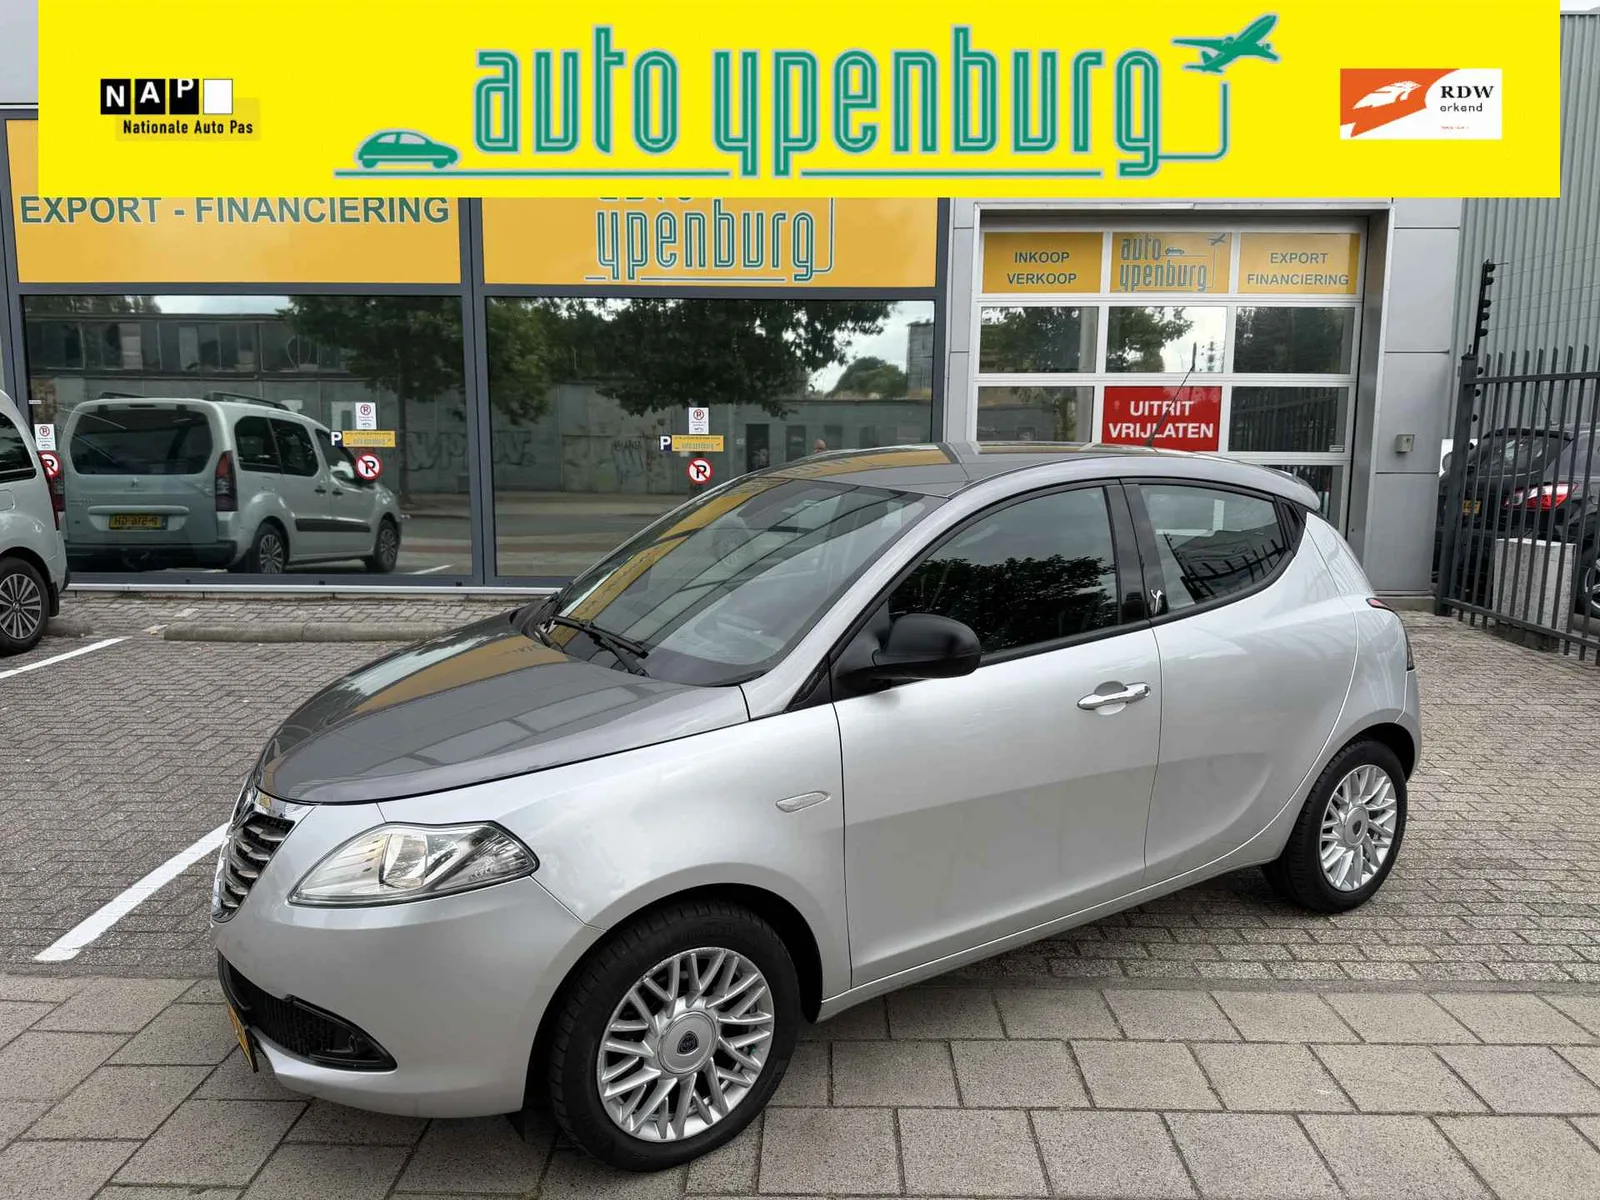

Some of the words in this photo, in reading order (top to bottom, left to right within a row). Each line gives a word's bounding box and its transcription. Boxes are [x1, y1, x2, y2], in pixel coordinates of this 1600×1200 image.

[20, 196, 162, 223] EXPORT
[196, 197, 450, 223] FINANCIERING
[596, 199, 814, 282] ypenburg
[1120, 234, 1162, 261] auto
[1014, 251, 1070, 264] INKOOP
[1269, 252, 1329, 264] EXPORT
[1006, 272, 1078, 285] VERKOOP
[1119, 259, 1207, 292] ypenburg
[1247, 273, 1350, 286] FINANCIERING
[1129, 400, 1195, 416] UITRIT
[1108, 422, 1214, 439] VRIJLATEN
